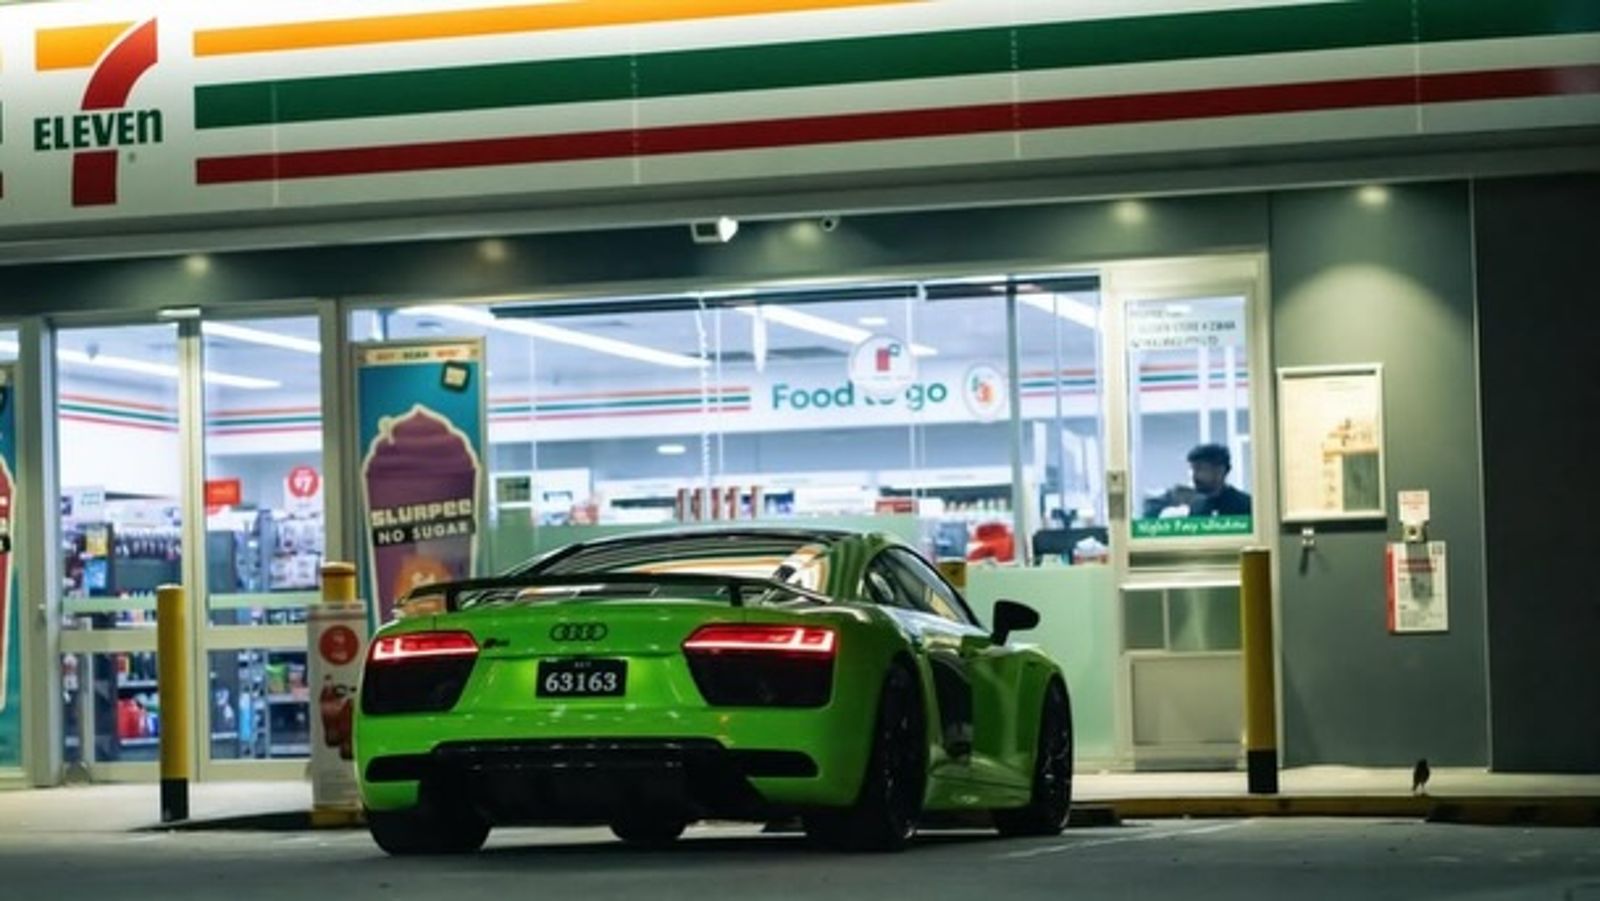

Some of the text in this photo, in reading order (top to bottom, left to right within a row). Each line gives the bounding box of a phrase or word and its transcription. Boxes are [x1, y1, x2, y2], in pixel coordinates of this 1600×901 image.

[36, 17, 158, 207] 7
[772, 380, 854, 410] Food
[906, 382, 947, 411] go
[371, 499, 471, 527] SLURPEE
[378, 521, 468, 544] NO SUGAR
[545, 671, 617, 692] 63163
